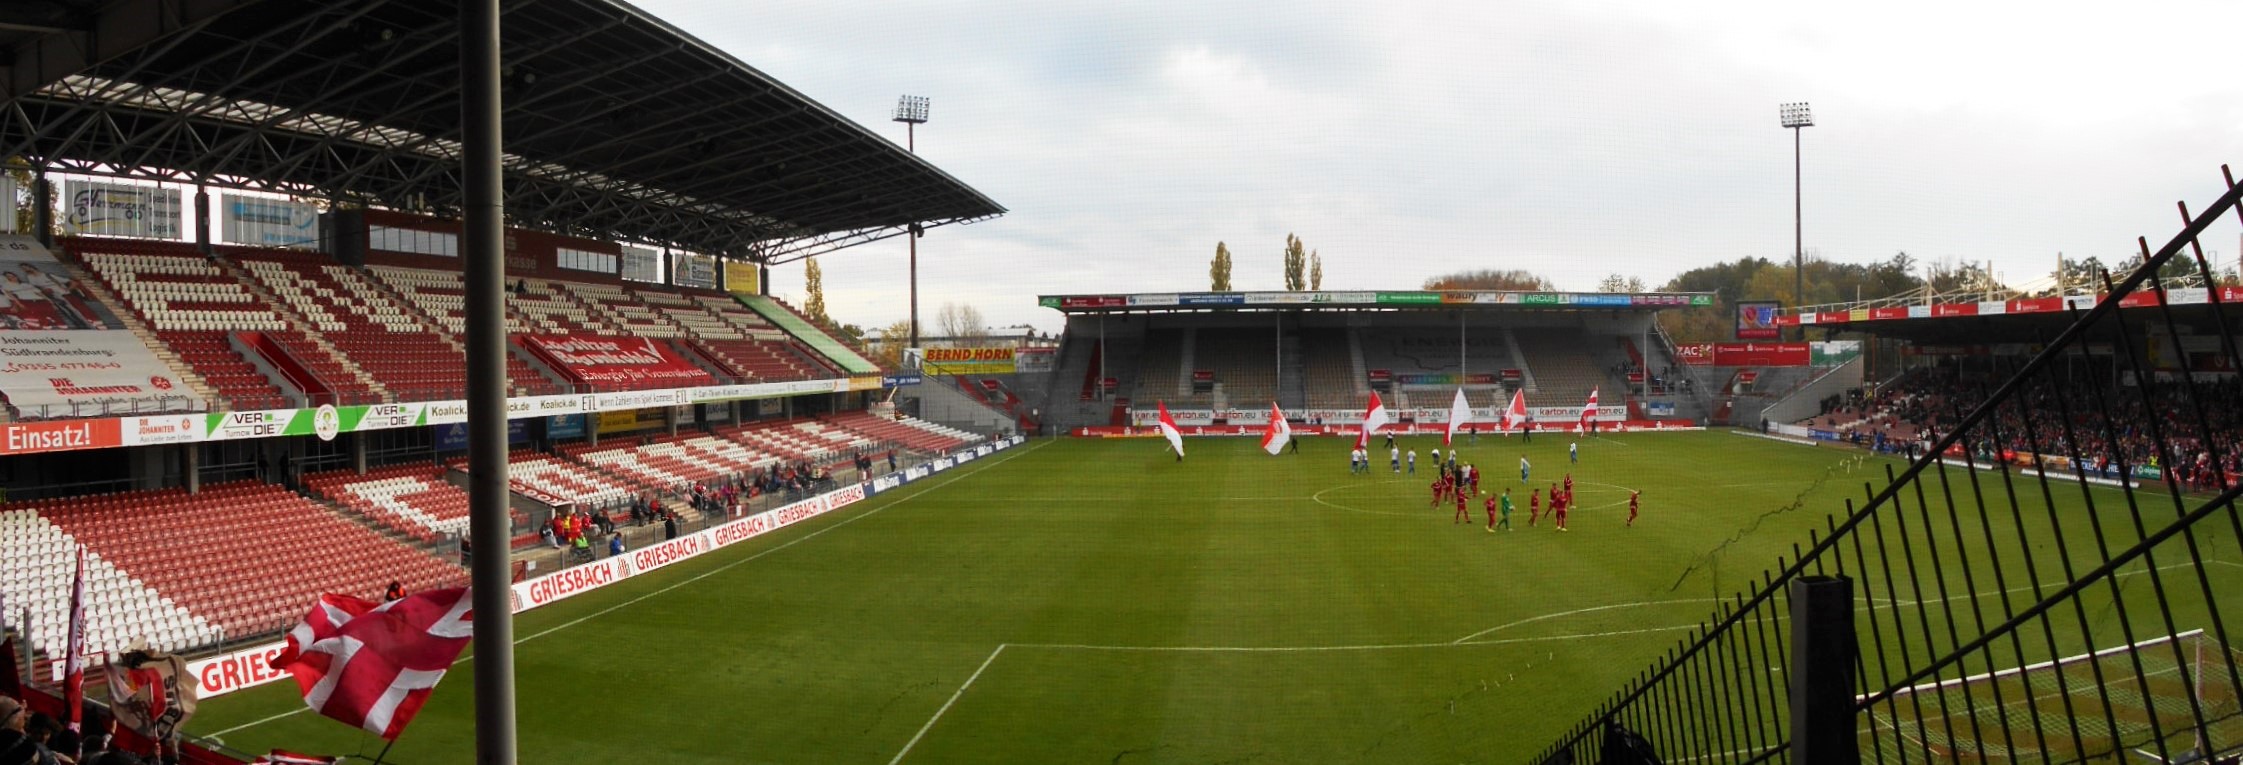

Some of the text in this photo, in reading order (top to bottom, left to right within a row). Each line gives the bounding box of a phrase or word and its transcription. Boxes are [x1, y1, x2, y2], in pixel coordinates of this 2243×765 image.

[1527, 294, 1556, 303] ARCUS
[2169, 291, 2186, 301] HSP
[1, 337, 71, 345] Johanniter
[926, 348, 1011, 362] BERND HORN
[49, 377, 75, 388] DIE
[56, 385, 142, 395] JOHANNITER
[540, 399, 577, 410] Koalick.de
[581, 395, 598, 411] ETL
[375, 405, 398, 416] VER
[431, 404, 468, 417] Koalick.
[1539, 408, 1579, 416] karton.eu
[139, 418, 149, 427] DIE
[234, 412, 264, 424] VER
[389, 415, 408, 426] DIE
[138, 424, 175, 435] JOHANNITER
[253, 424, 276, 436] DIE
[8, 422, 91, 450] Einsatz!
[830, 487, 863, 508] GRIESBACH
[778, 500, 818, 524] GRIESBACH
[715, 517, 764, 545] GRIESBACH
[635, 536, 698, 571] GRIESBACH
[530, 562, 612, 604] GRIESBACH
[202, 649, 289, 693] GRIES
